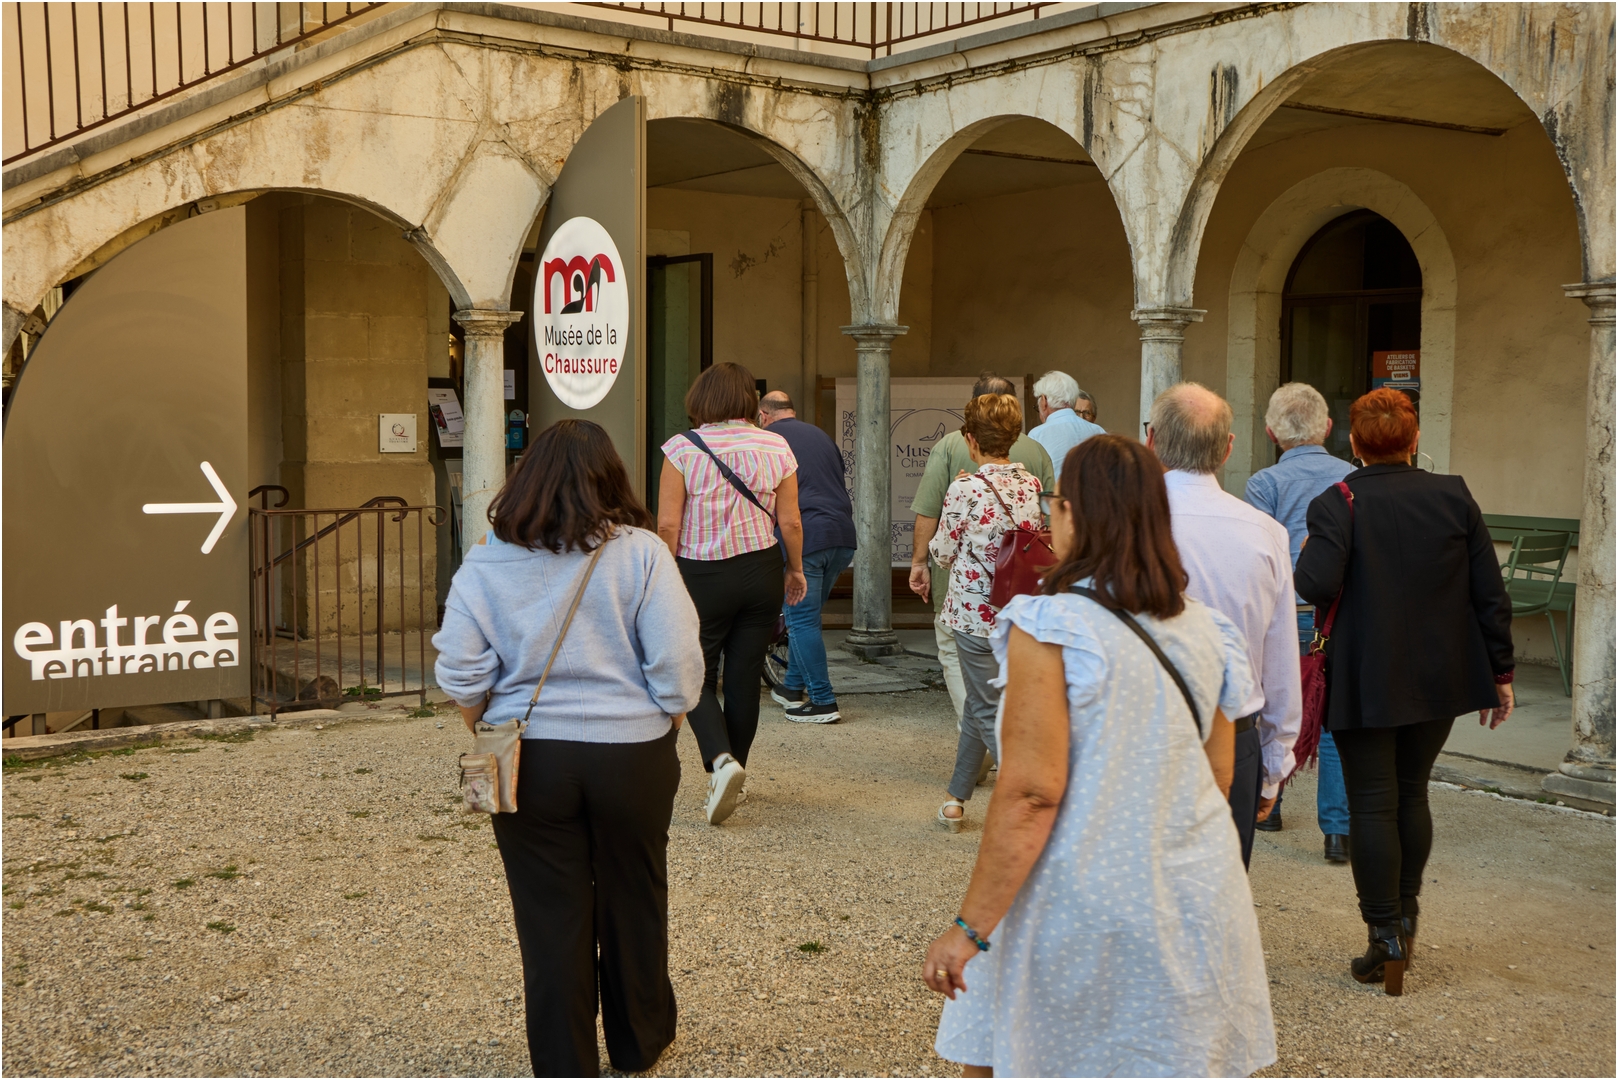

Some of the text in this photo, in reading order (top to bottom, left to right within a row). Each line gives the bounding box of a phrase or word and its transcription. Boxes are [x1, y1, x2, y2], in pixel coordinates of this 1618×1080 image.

[544, 323, 617, 346] Musée de la
[544, 353, 618, 374] Chaussure
[896, 444, 930, 457] Mus
[901, 458, 927, 468] Cha
[13, 599, 239, 661] entrée
[43, 648, 236, 680] entrance
